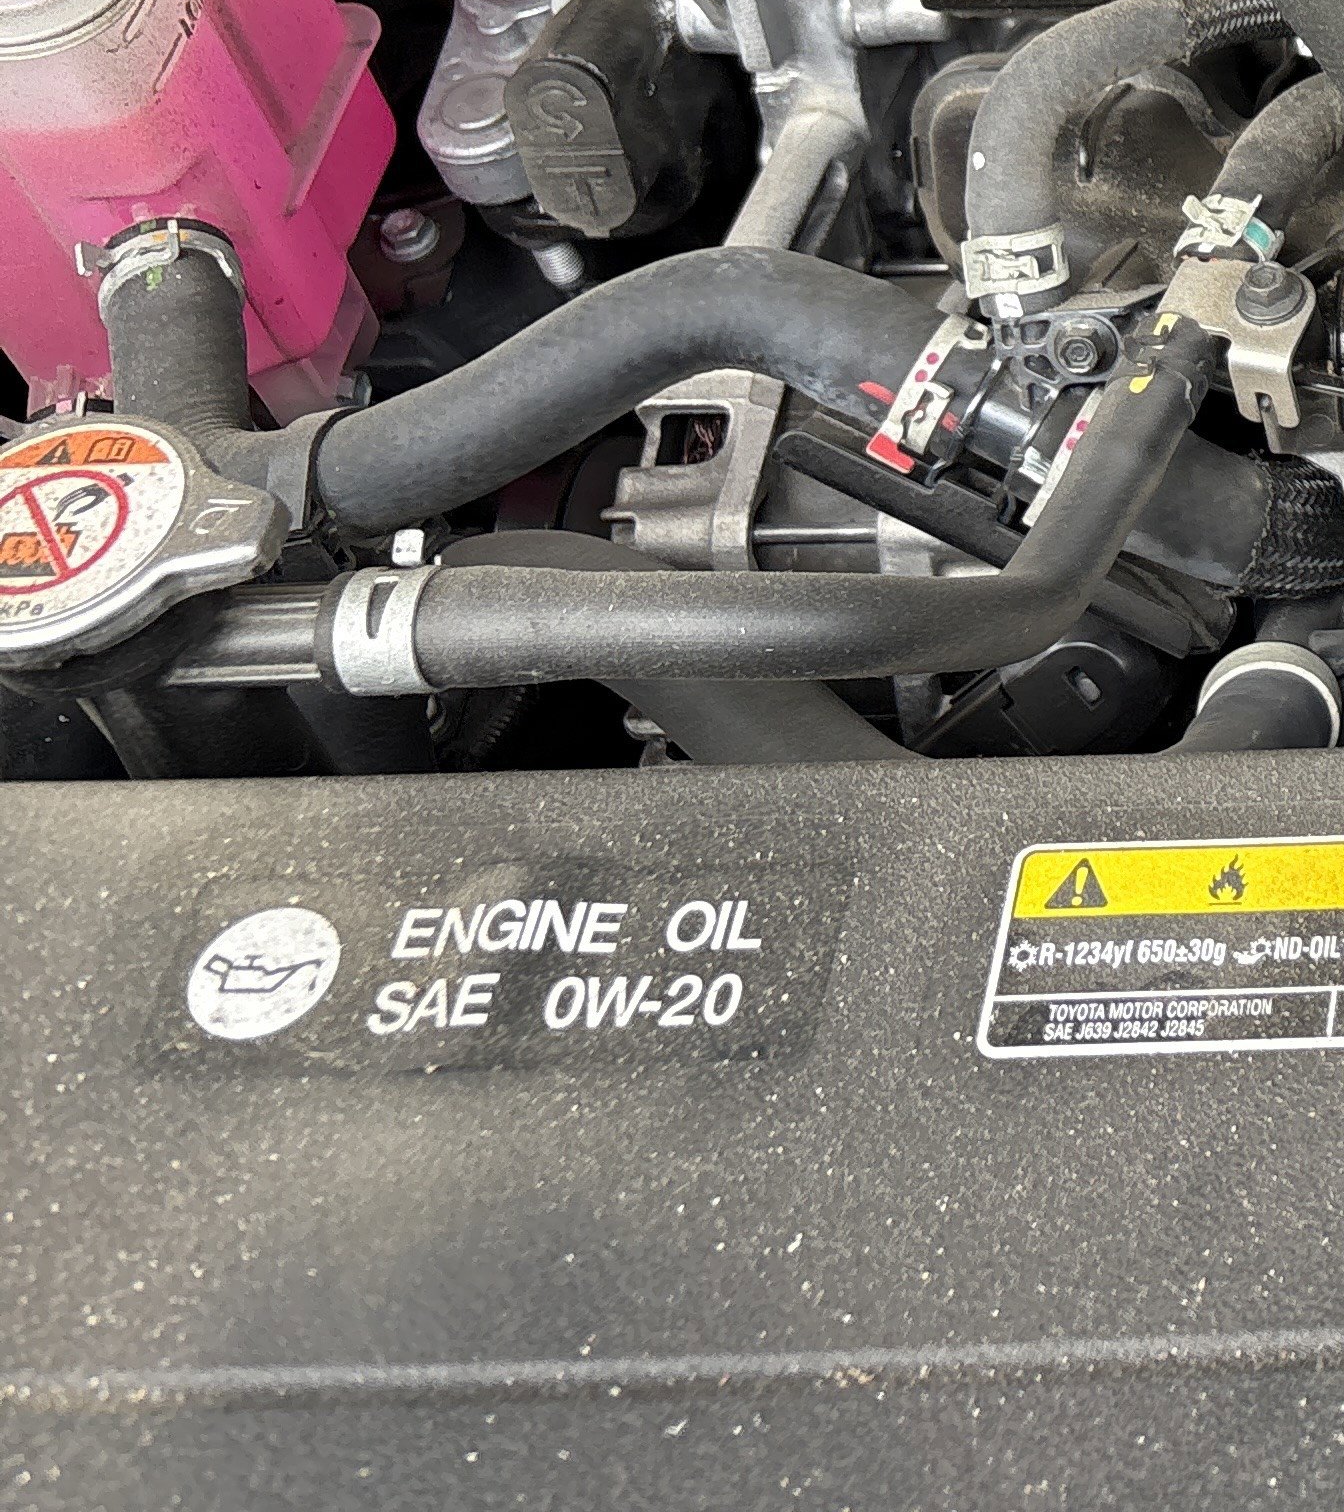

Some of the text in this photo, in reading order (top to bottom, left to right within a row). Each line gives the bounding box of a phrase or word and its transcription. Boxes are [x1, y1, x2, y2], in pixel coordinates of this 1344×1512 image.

[390, 899, 762, 960] ENGINE OIL
[1037, 939, 1135, 969] R-1234yf
[1137, 937, 1227, 967] 650±30g
[367, 972, 744, 1036] SAE 0W-20
[1047, 998, 1274, 1022] TOYOTA MOTOR CORPORATION
[1042, 1019, 1206, 1042] SAE J639 J2842 J2845
